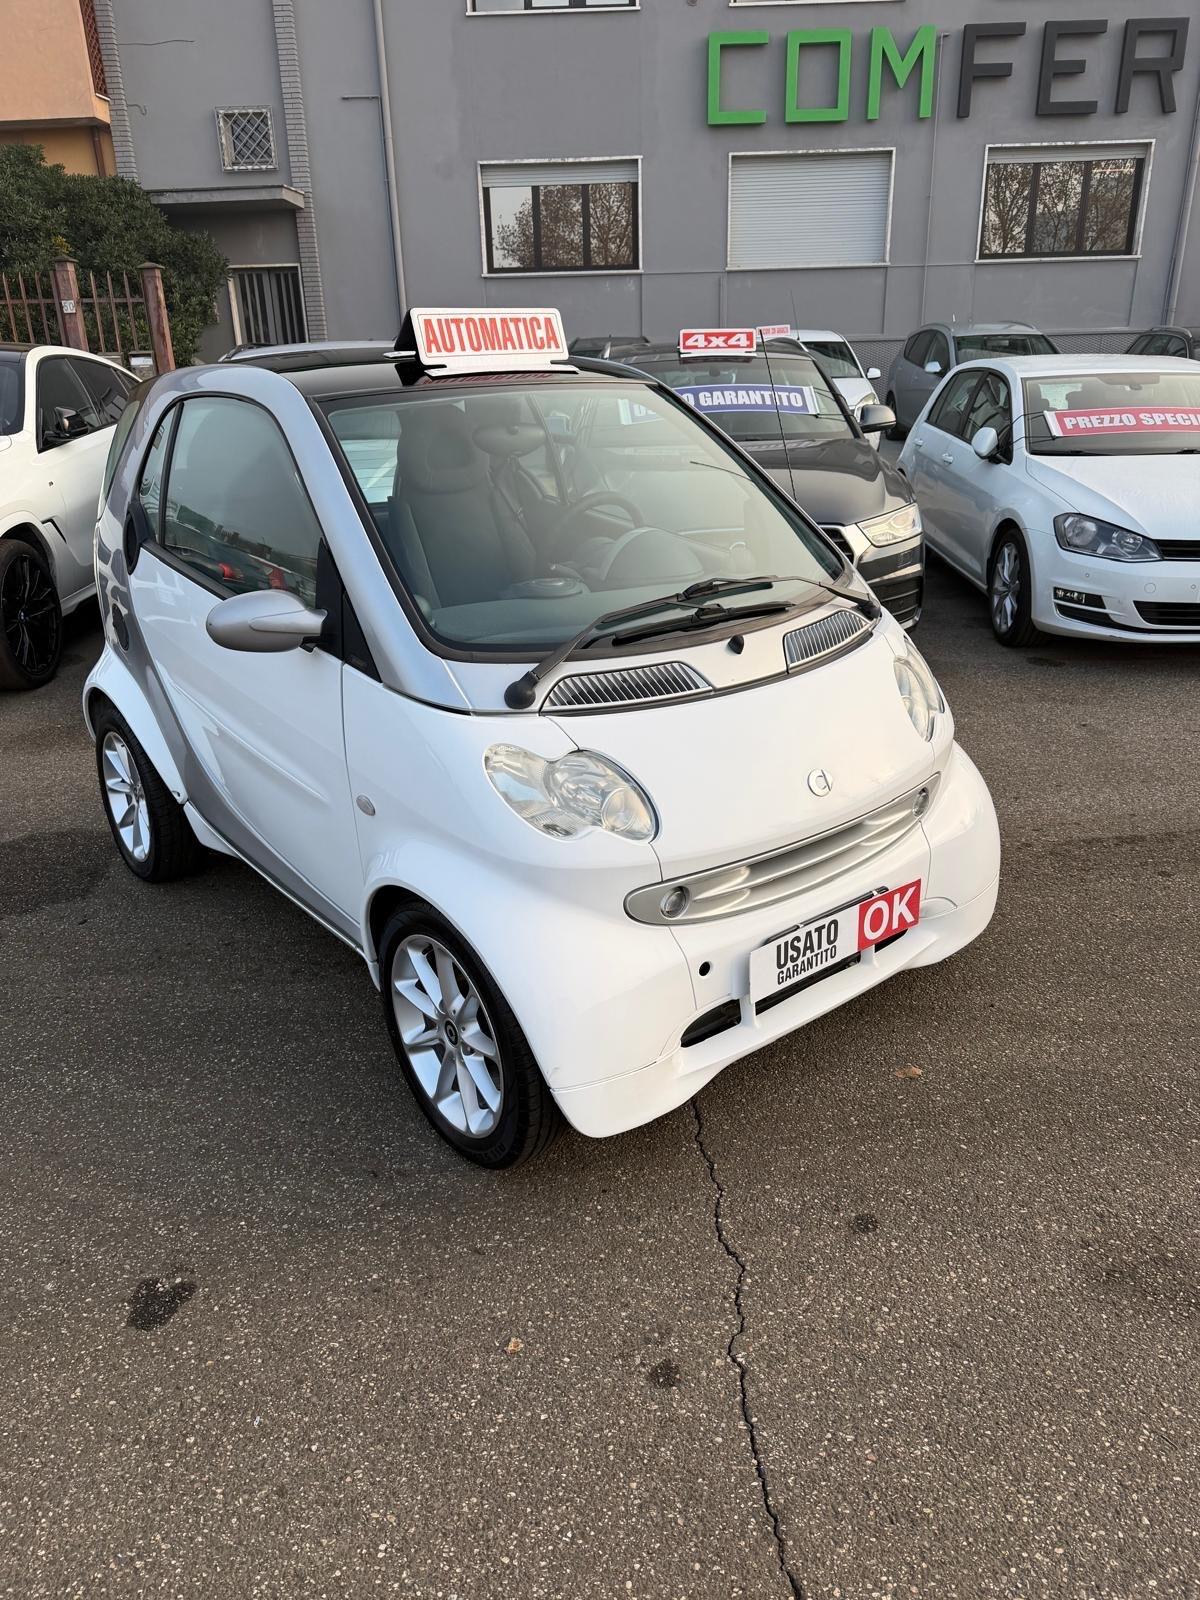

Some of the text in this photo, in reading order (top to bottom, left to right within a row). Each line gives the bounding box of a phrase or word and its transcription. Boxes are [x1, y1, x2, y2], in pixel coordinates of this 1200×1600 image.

[707, 17, 1190, 125] COMFER
[423, 316, 560, 353] AUTOMATICA
[685, 333, 750, 348] 4x4
[699, 389, 804, 407] GARANTITO
[1063, 412, 1200, 430] PREZZO SPECI
[863, 886, 917, 941] OK
[776, 919, 839, 970] USATO
[777, 945, 837, 985] GARANTITO
